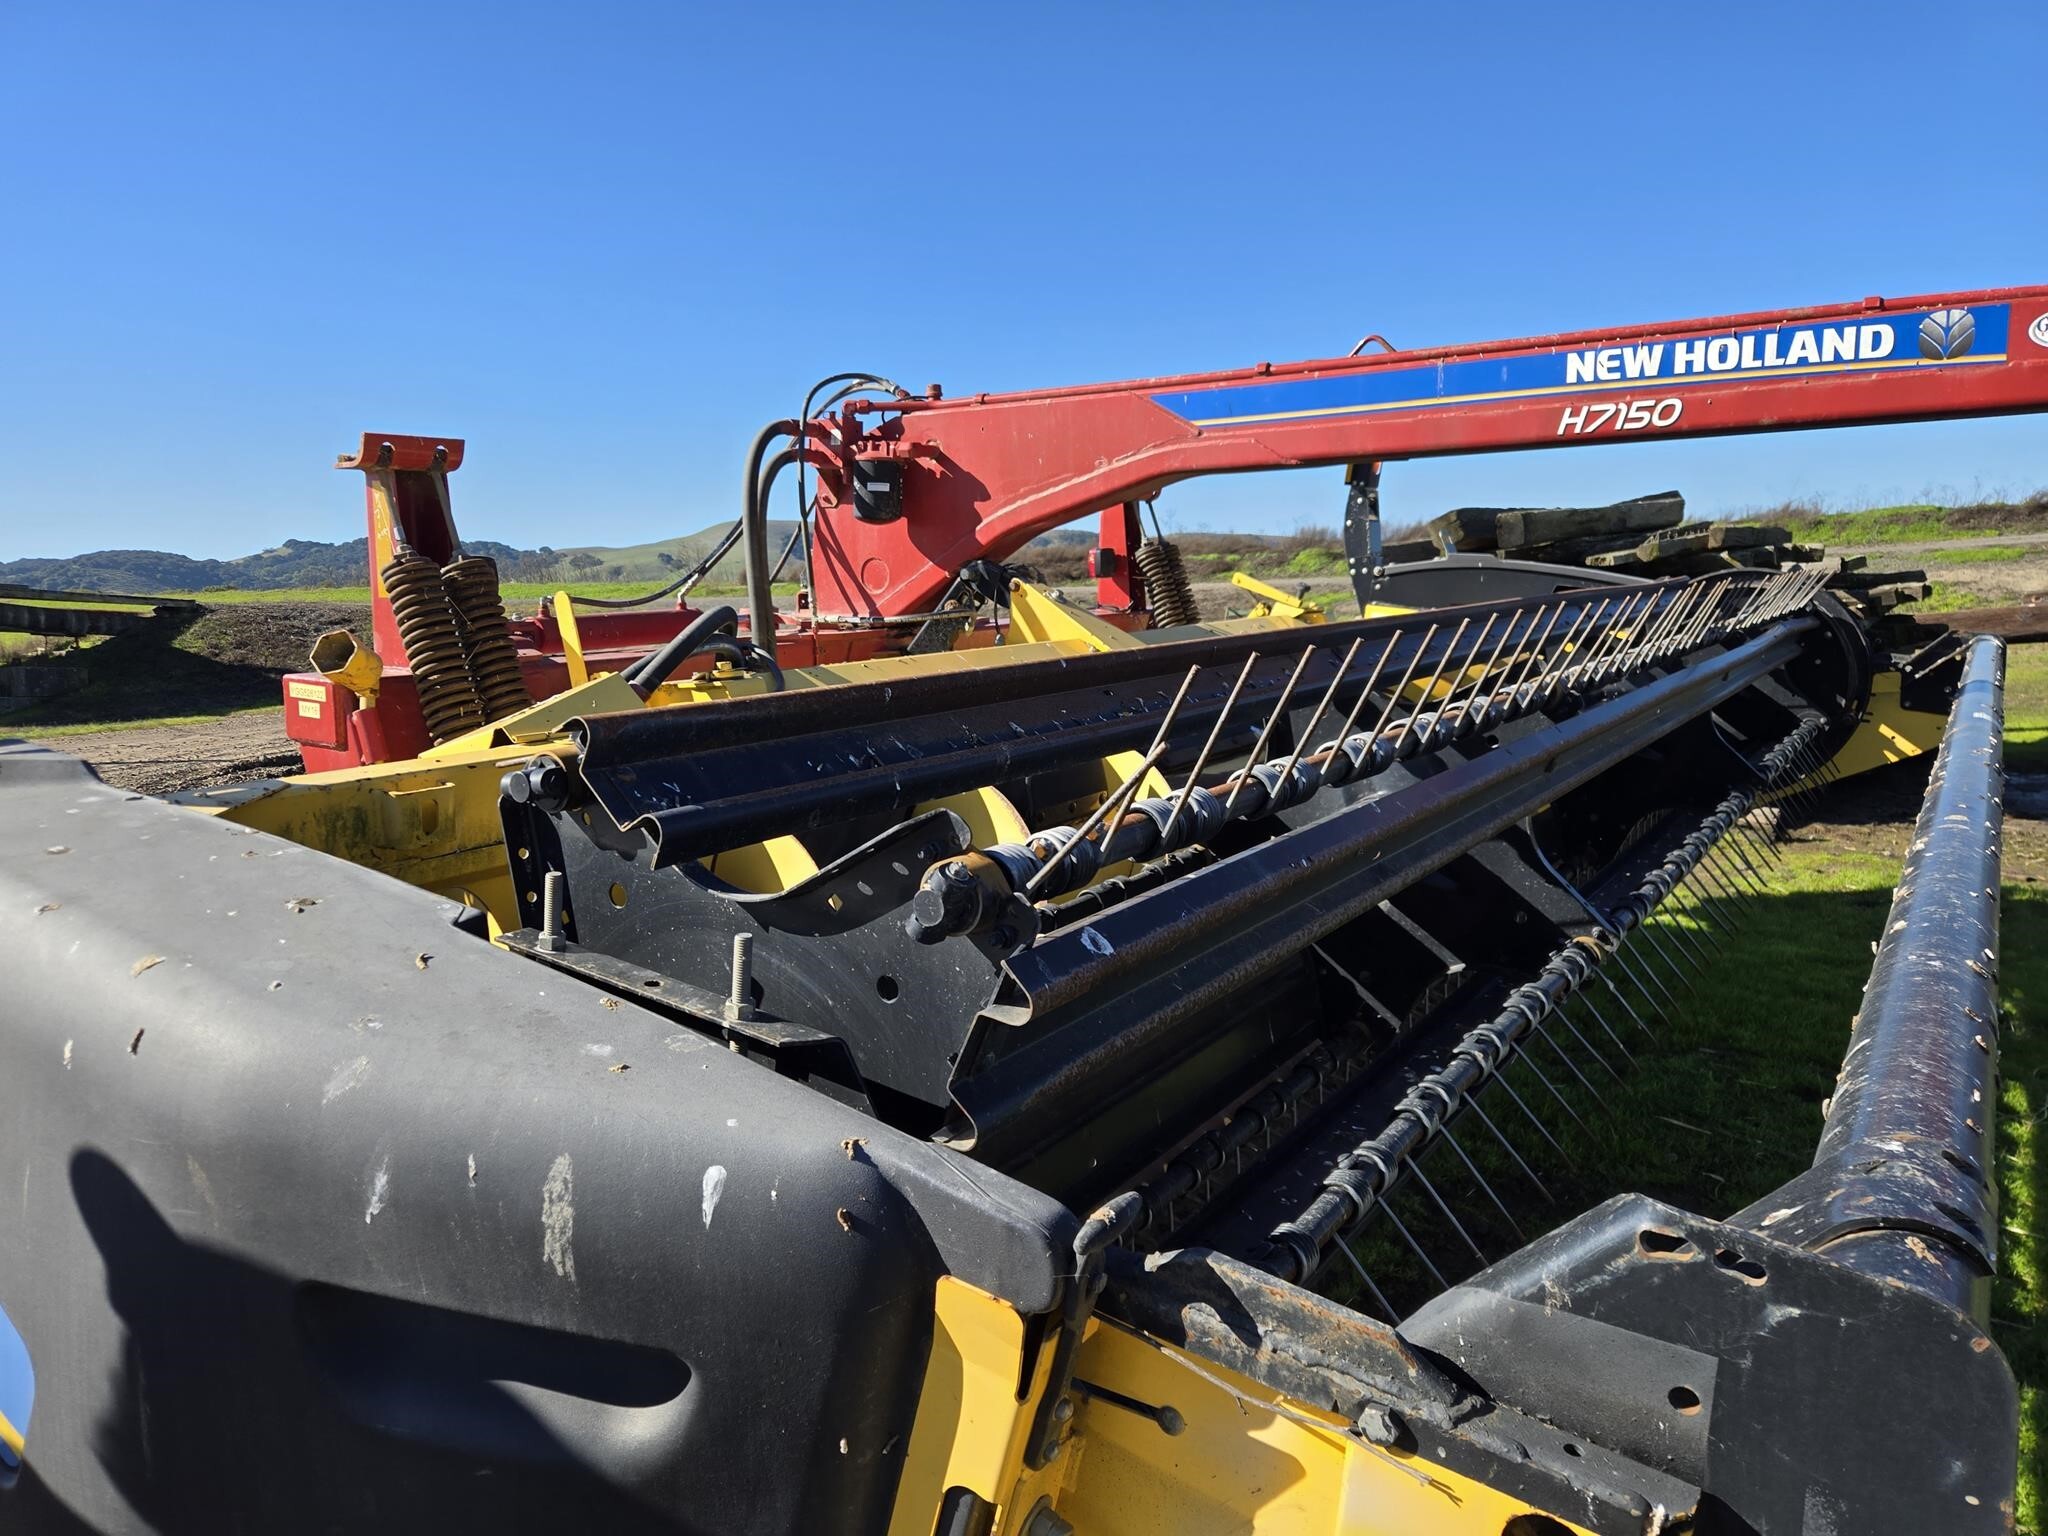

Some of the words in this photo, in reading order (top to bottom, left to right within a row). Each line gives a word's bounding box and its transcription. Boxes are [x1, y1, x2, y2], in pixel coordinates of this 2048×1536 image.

[1566, 345, 1664, 384] NEW
[1674, 324, 1894, 374] HOLLAND
[1557, 398, 1683, 435] H7150
